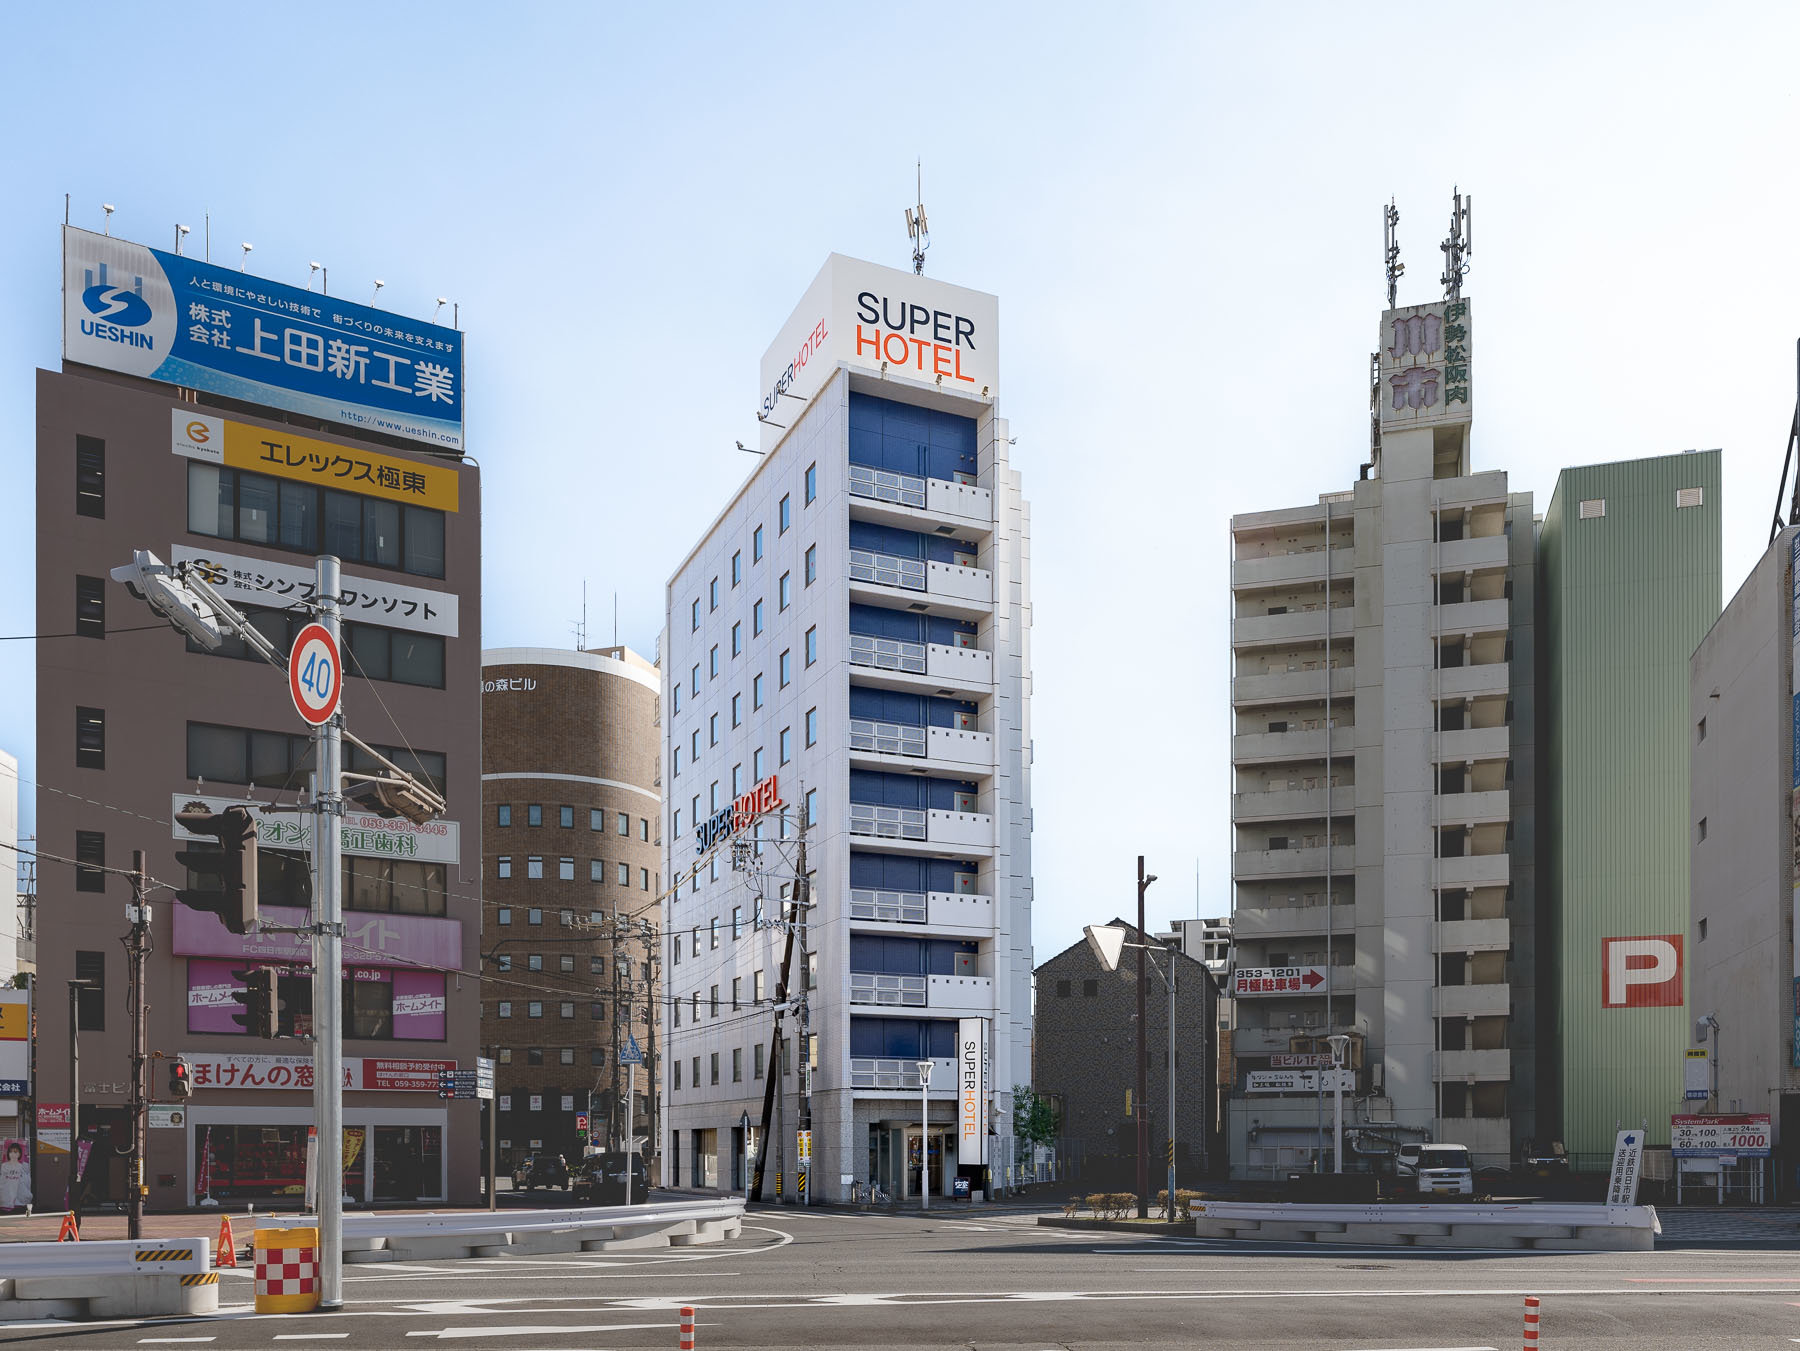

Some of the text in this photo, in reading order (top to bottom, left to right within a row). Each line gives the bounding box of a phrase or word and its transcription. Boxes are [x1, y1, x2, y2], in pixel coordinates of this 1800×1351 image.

[81, 318, 153, 351] UESHIN
[189, 276, 454, 352] 人と環境にやさしい技術で 街づくりの未来を支えます
[189, 302, 232, 328] 株式
[857, 292, 976, 350] SUPER
[189, 325, 230, 350] 会社
[856, 324, 975, 382] HOTEL
[1444, 302, 1468, 406] 伊勢松阪肉
[236, 318, 454, 406] 上田新工業
[341, 409, 459, 445] http://www.ueshin.com
[260, 440, 426, 495] エレックス極東
[256, 574, 437, 620] シンプワンソフト
[302, 652, 330, 698] 40
[1236, 968, 1300, 978] 353-1201
[1236, 978, 1301, 992] 月極駐車場
[1608, 940, 1676, 1004] P
[192, 991, 239, 1003] ホームメイ
[396, 1000, 442, 1012] ホームメイト
[376, 1062, 446, 1070] 無料相談予約受付中
